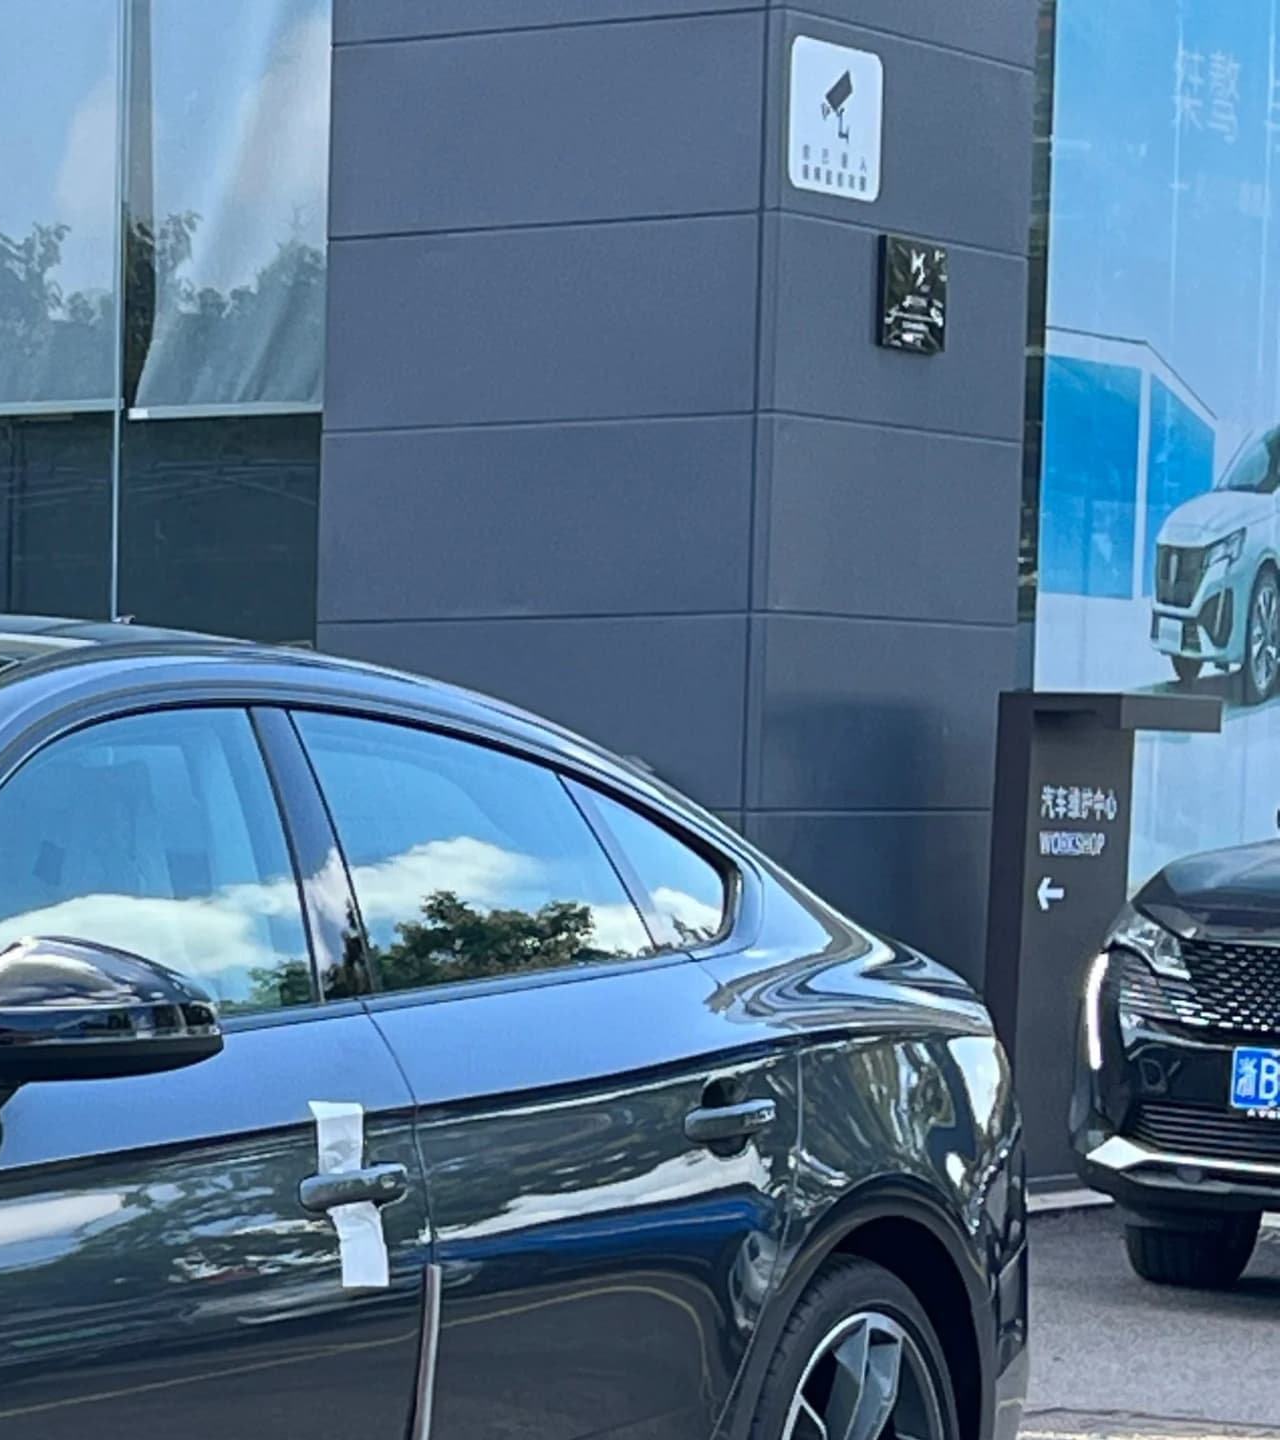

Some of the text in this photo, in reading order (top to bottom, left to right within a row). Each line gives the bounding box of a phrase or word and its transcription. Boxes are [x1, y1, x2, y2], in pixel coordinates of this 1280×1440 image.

[1040, 785, 1117, 821] 汽车维护中心
[1040, 831, 1105, 856] WORKSHOP
